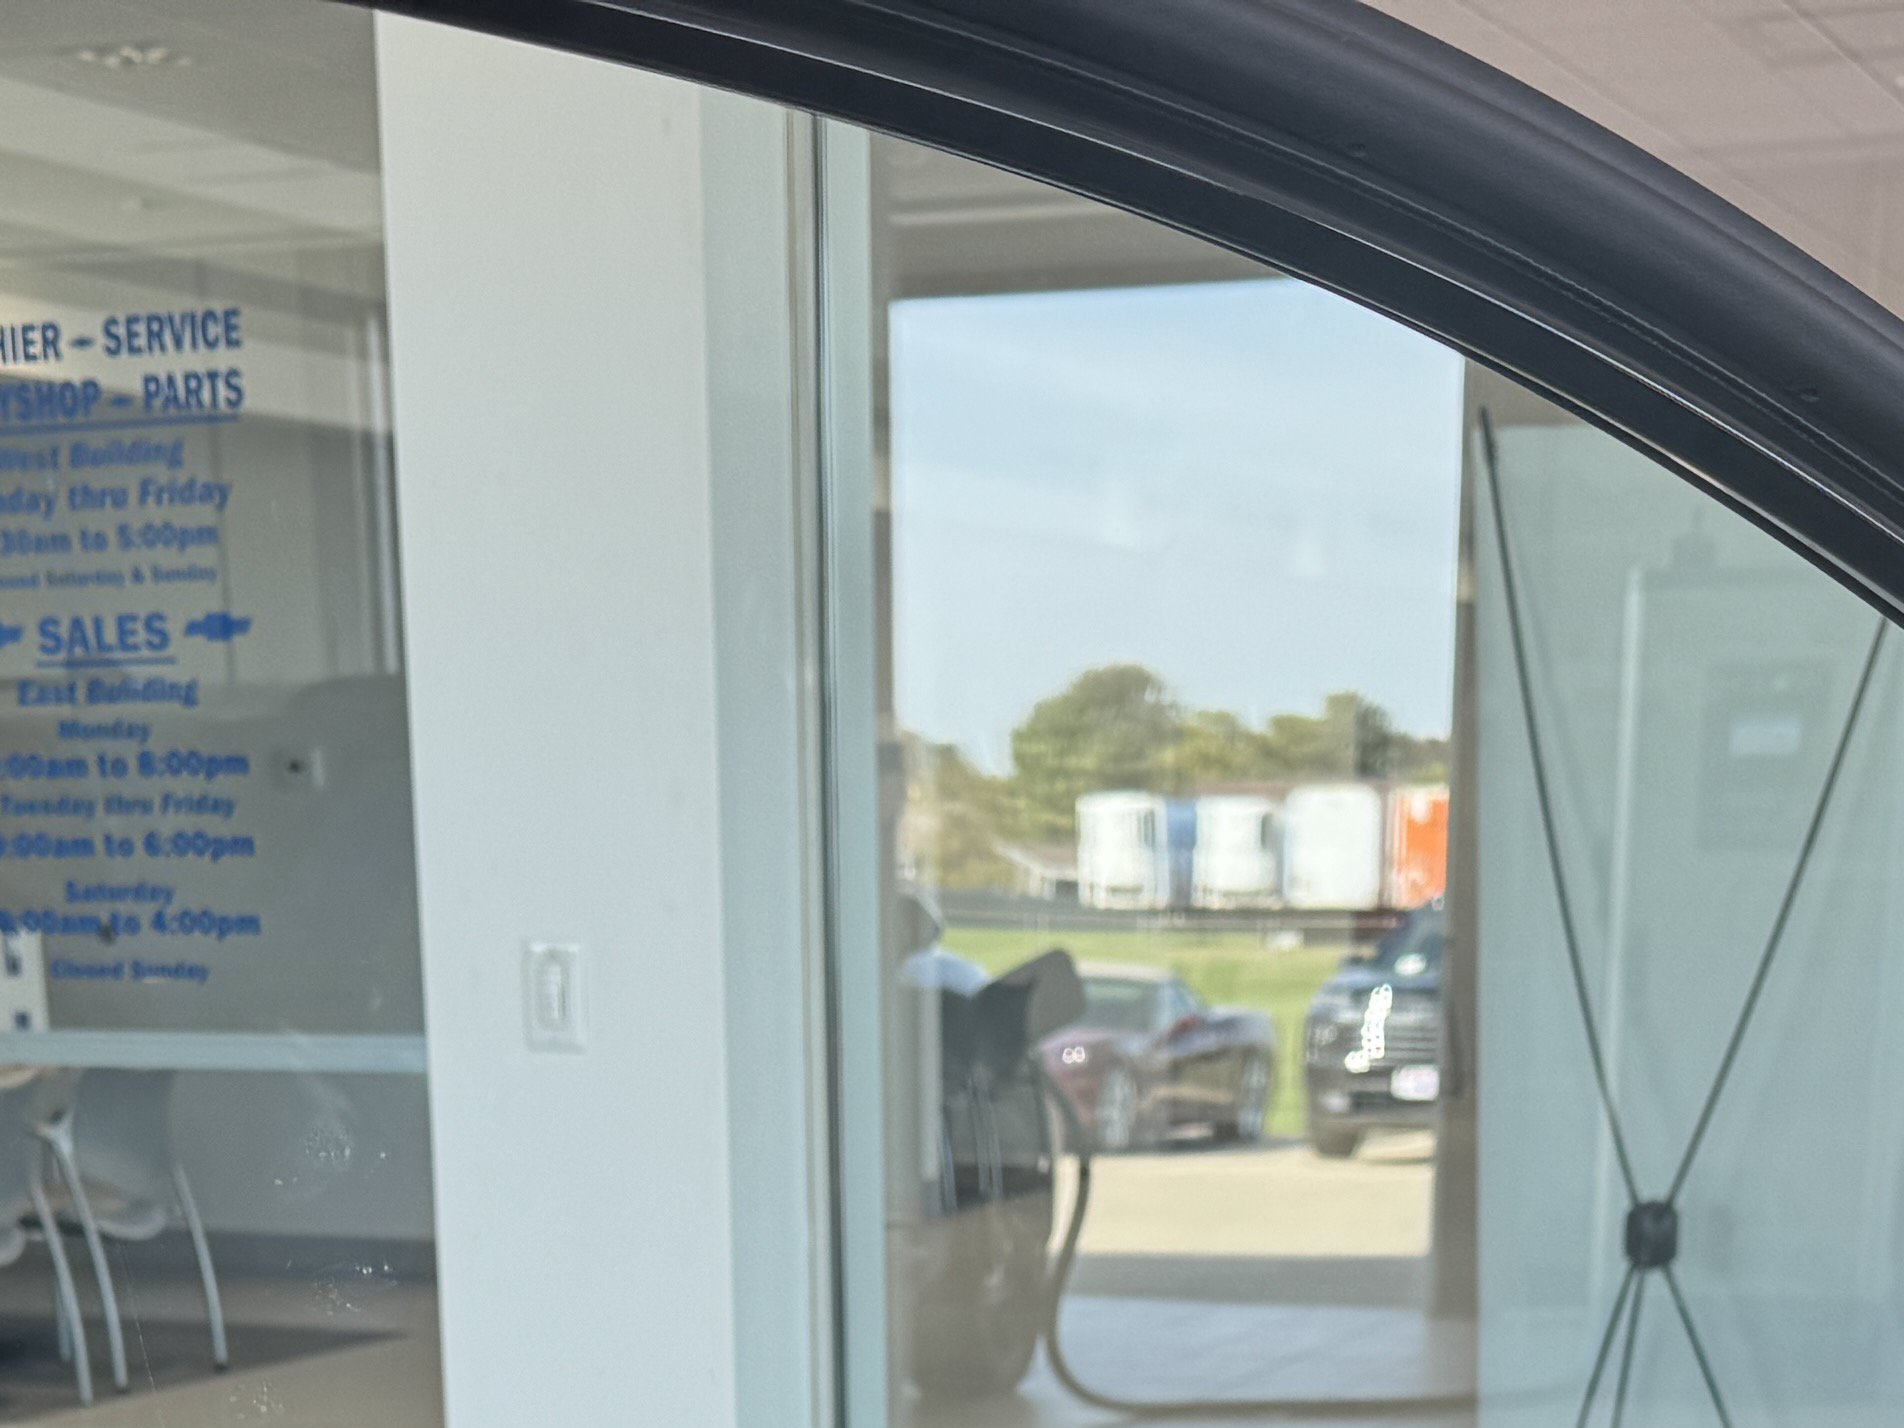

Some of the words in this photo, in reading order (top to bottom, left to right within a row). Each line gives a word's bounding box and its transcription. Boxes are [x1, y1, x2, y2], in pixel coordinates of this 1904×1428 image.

[102, 307, 242, 358] SERVICE
[142, 367, 245, 412] PARTS
[68, 440, 185, 470] Building
[68, 485, 129, 511] thru
[139, 477, 232, 512] Friday
[79, 528, 108, 551] to
[38, 612, 170, 656] SALES
[17, 680, 77, 706] East
[86, 678, 198, 708] Building
[59, 719, 151, 743] Monday
[98, 754, 129, 778] to
[0, 795, 94, 820] Tuesday
[104, 795, 153, 815] thru
[161, 793, 235, 819] Friday
[104, 833, 134, 858] to
[65, 880, 174, 905] Saturday
[108, 911, 139, 935] to
